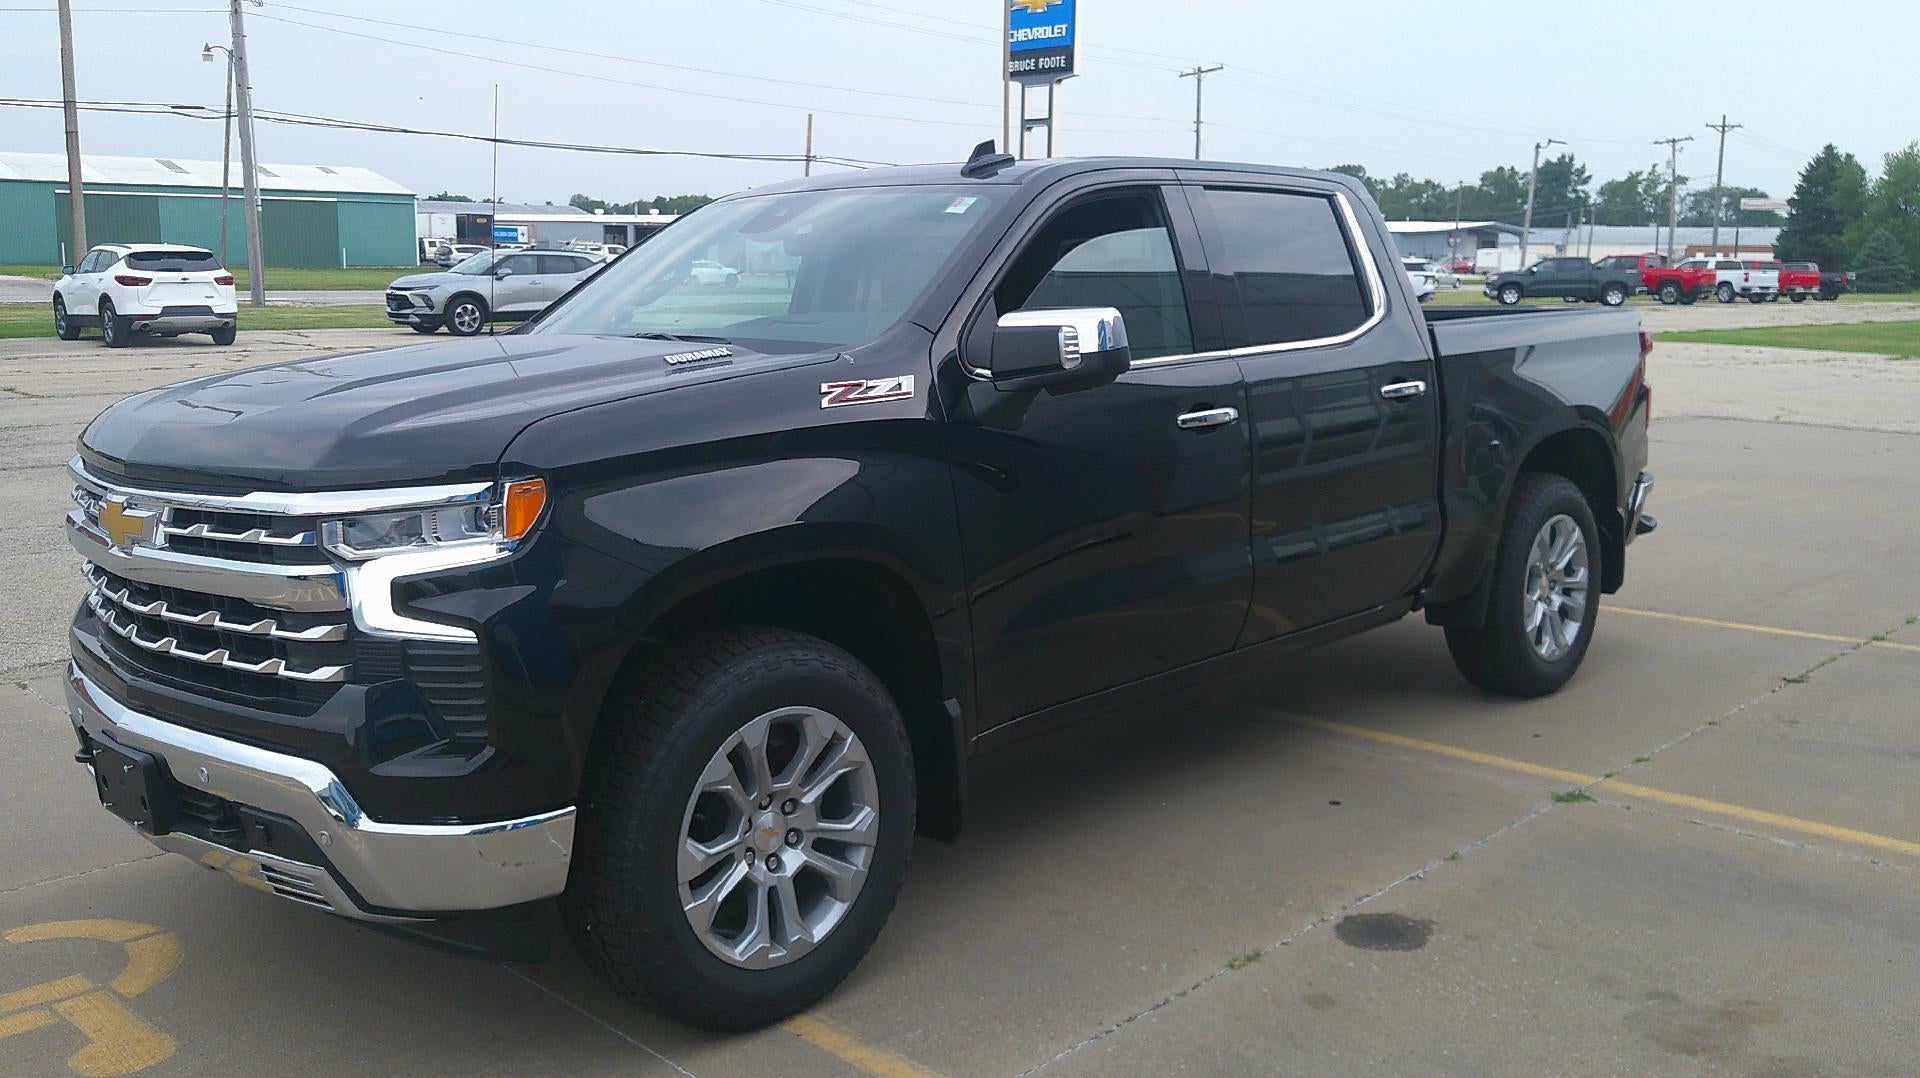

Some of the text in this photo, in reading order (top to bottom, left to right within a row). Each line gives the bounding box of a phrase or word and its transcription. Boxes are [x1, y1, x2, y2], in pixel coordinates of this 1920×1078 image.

[1009, 24, 1068, 42] CHEVROLET
[1009, 56, 1066, 72] BRUCE FOOTE
[664, 347, 732, 364] DURAMAX
[821, 375, 914, 408] Z71
